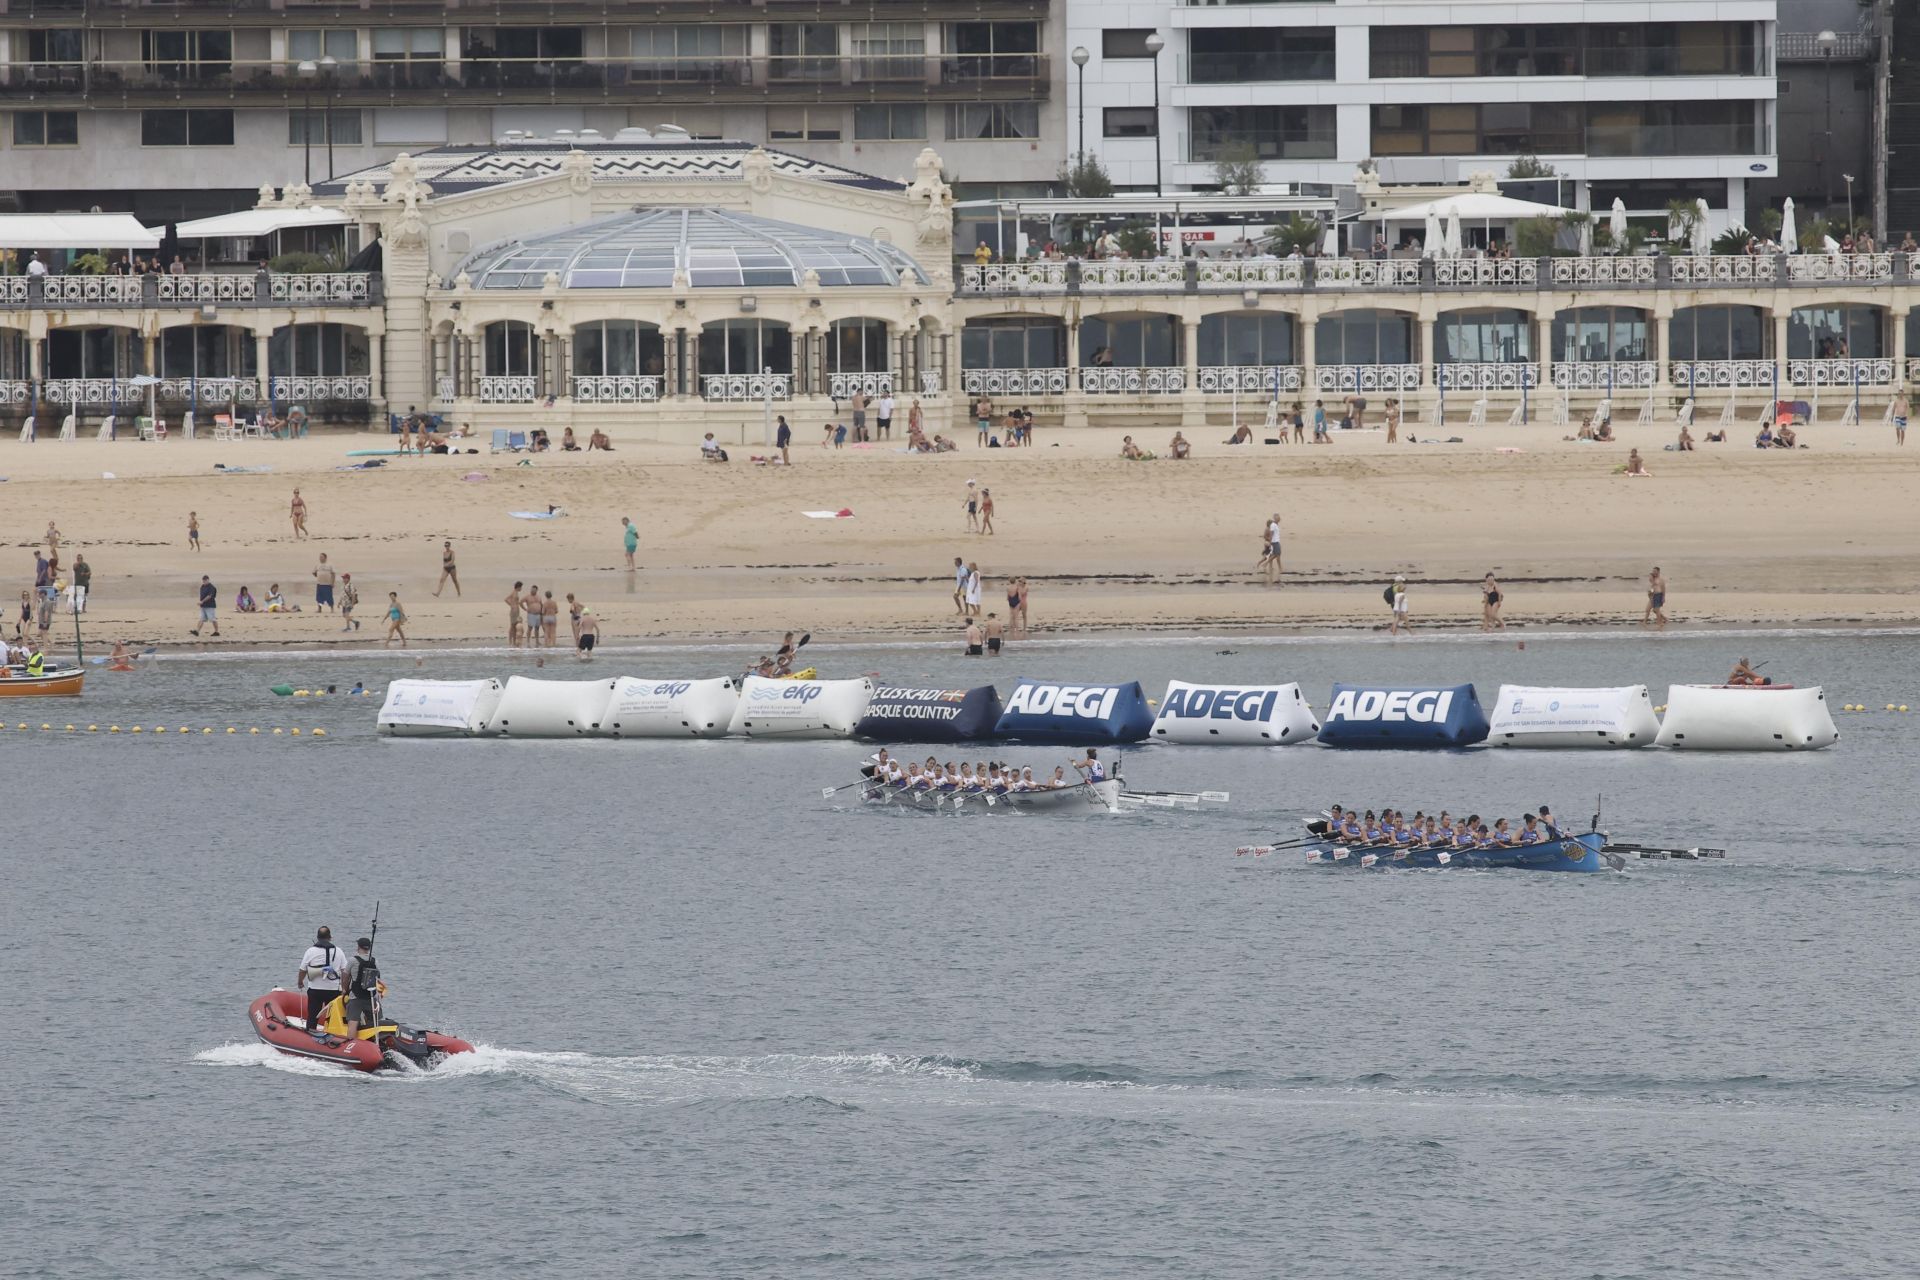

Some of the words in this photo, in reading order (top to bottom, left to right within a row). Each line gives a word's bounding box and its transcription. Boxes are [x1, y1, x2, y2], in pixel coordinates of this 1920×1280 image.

[653, 681, 691, 699] ekp
[783, 683, 822, 704] ekp
[872, 687, 944, 701] EUSKADI
[902, 705, 962, 720] COUNTRY
[1003, 684, 1119, 720] ADEGI
[1158, 688, 1279, 722] ADEGI
[1325, 690, 1454, 723] ADEGI
